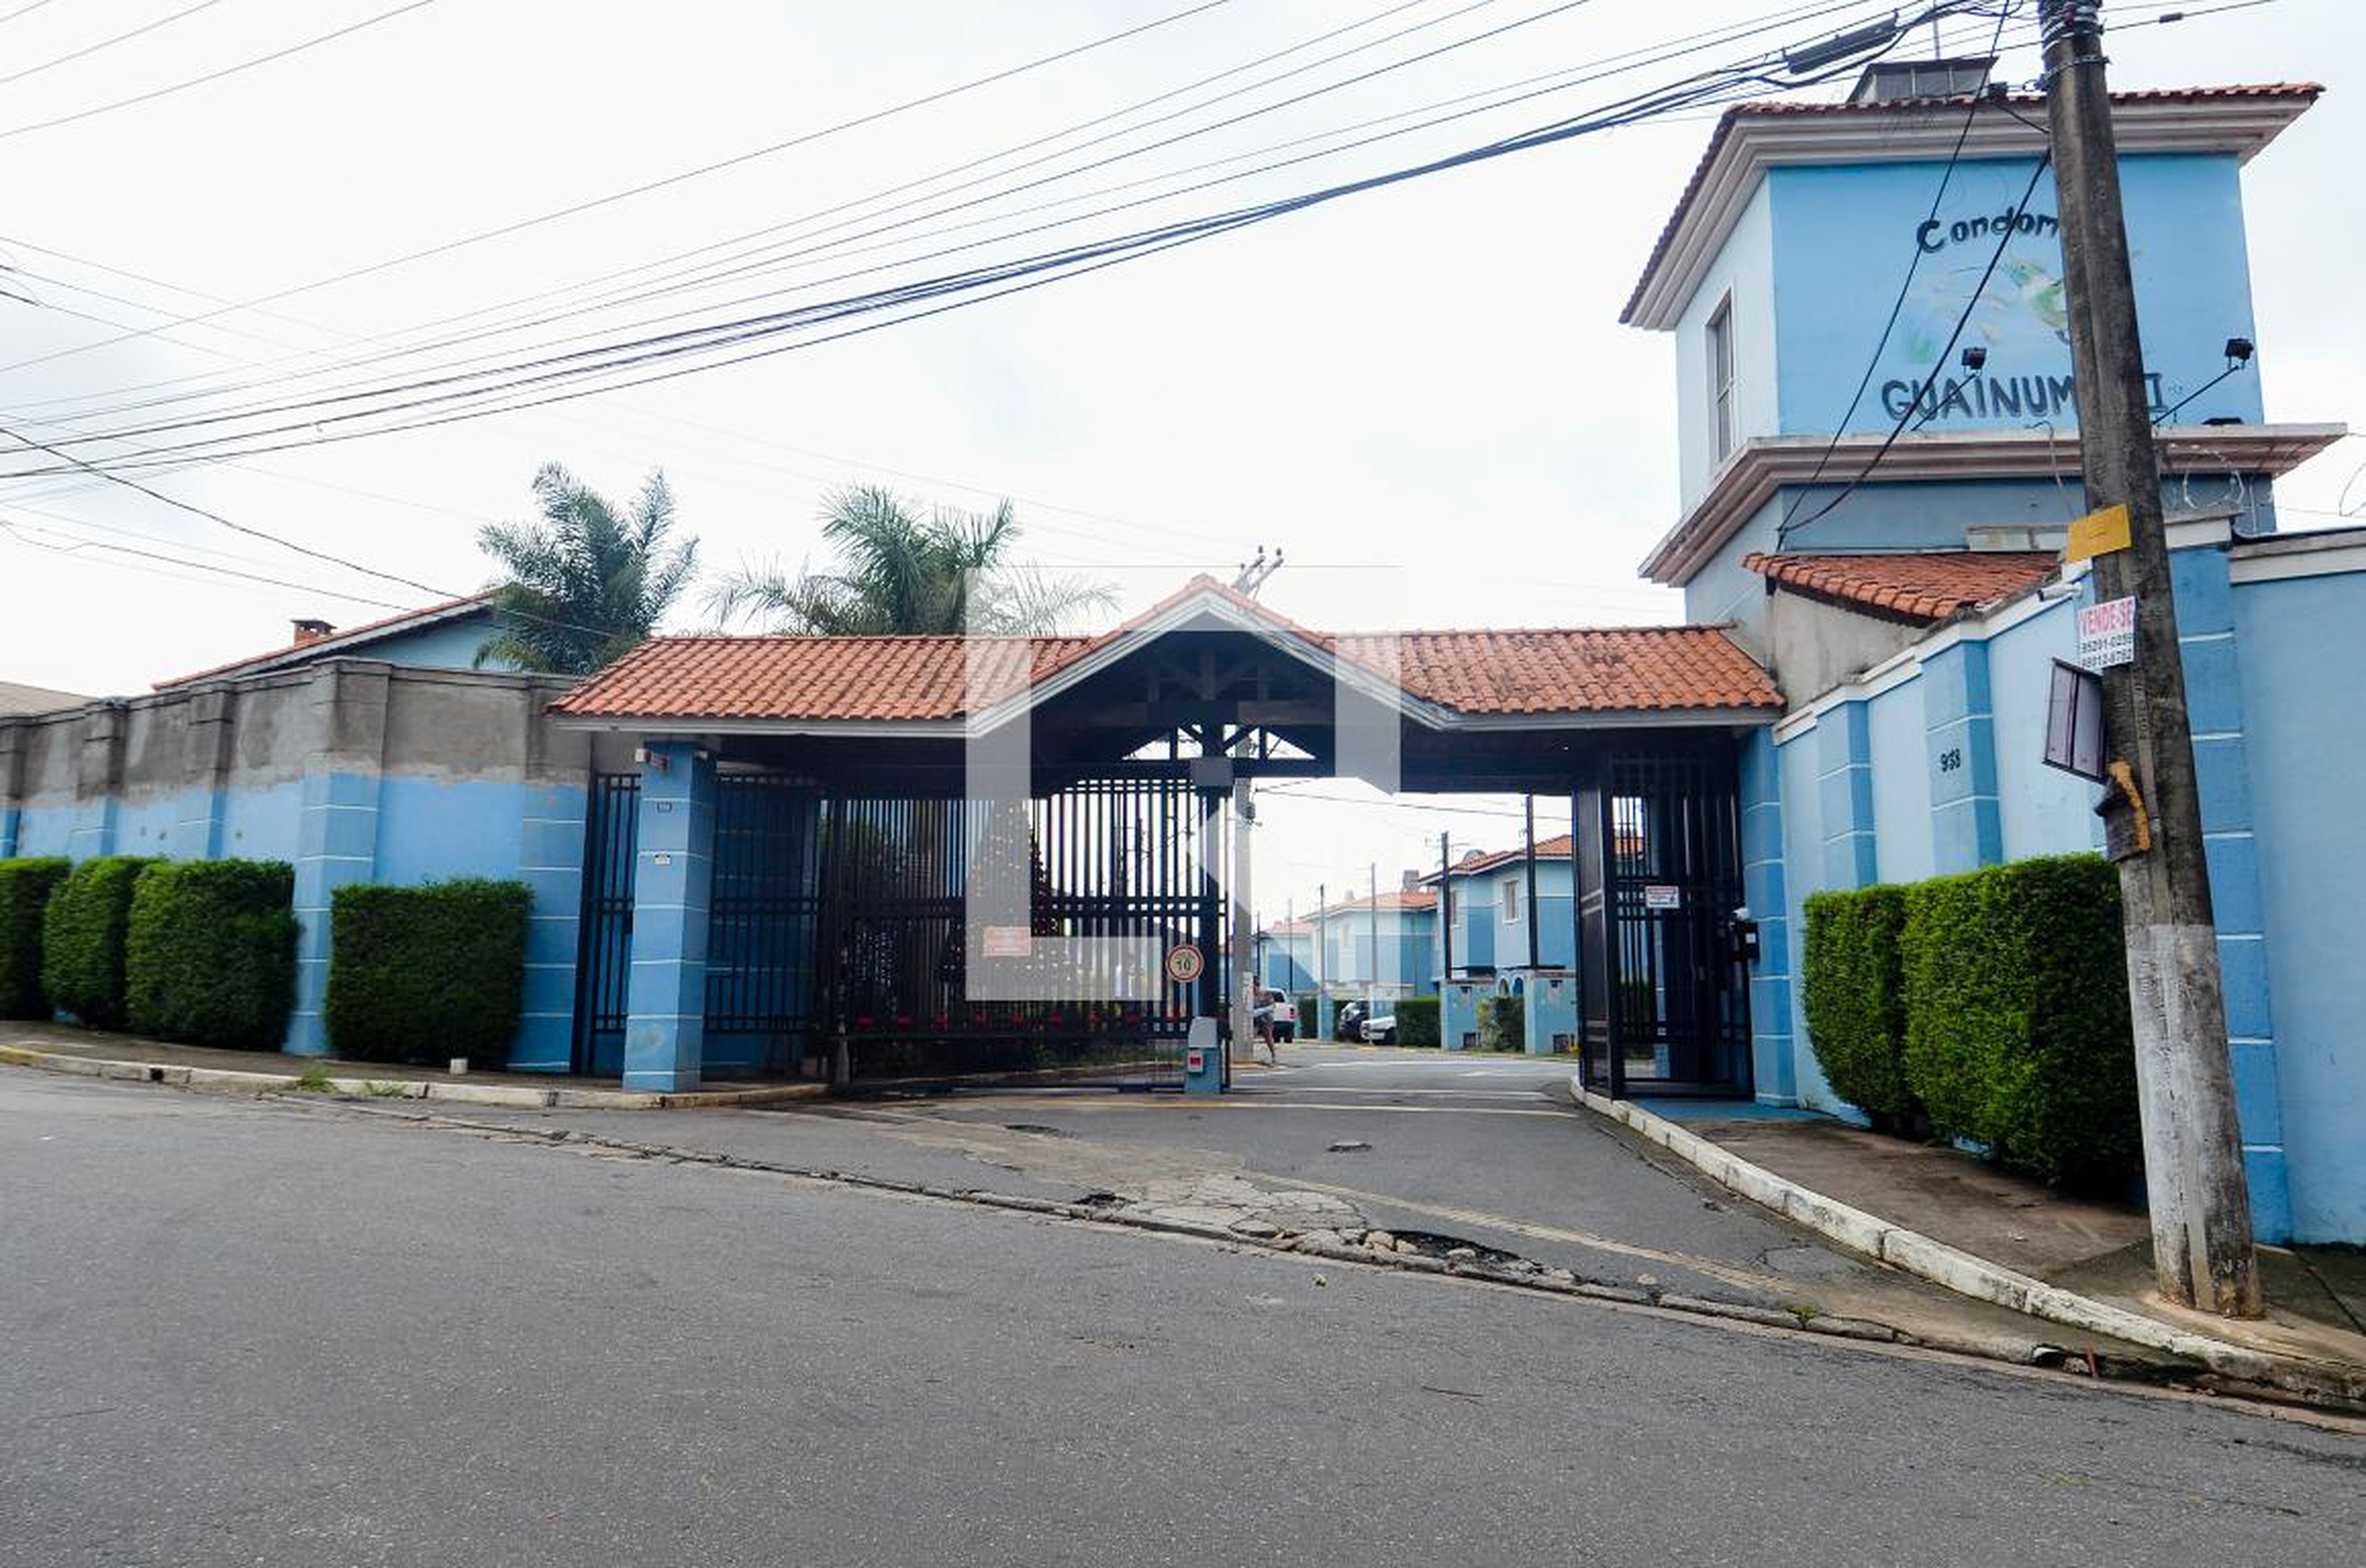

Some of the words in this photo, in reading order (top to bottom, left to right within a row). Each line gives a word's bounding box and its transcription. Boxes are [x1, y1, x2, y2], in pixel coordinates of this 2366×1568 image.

[1916, 206, 2059, 253] Condom
[1881, 373, 2075, 421] GUAINUM
[1176, 957, 1190, 970] 10
